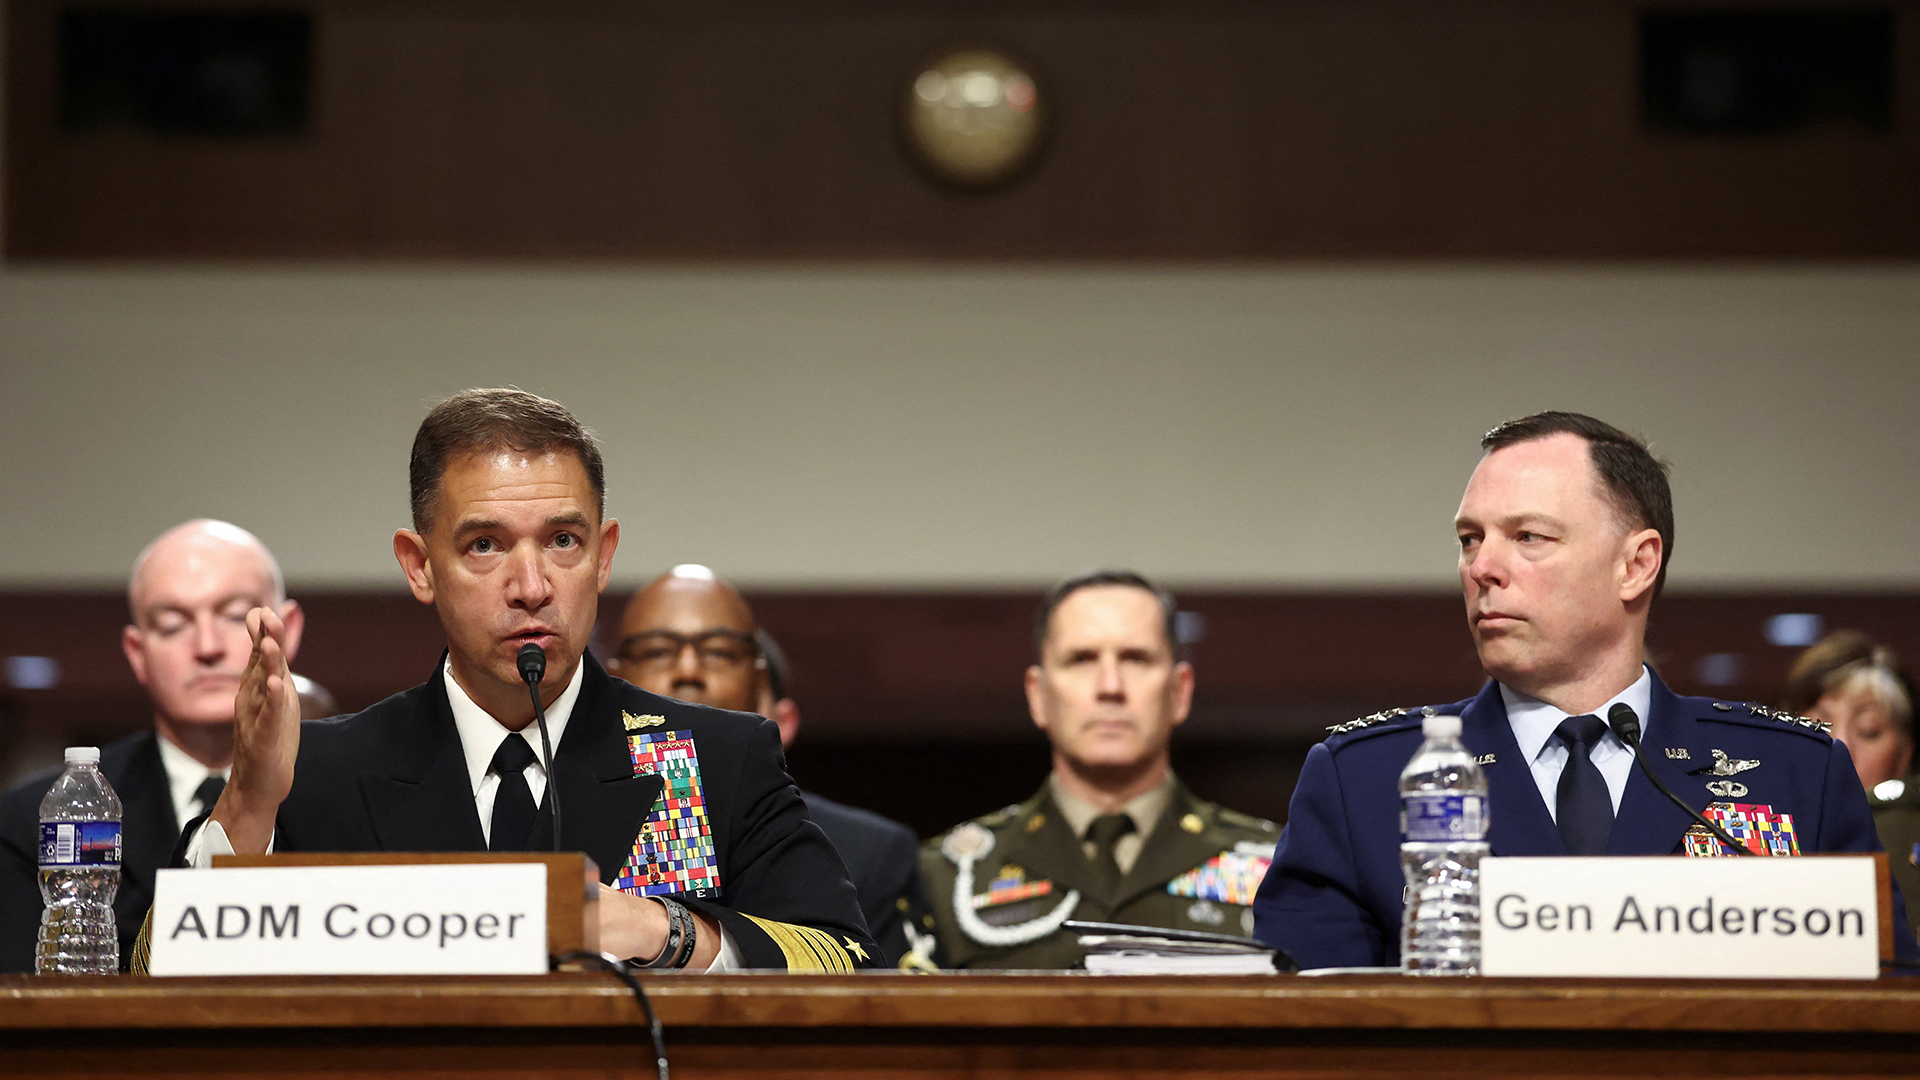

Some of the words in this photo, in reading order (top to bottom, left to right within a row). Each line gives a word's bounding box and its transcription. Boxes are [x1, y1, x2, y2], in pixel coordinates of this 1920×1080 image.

[695, 888, 707, 898] E
[1494, 893, 1593, 932] Gen
[1613, 895, 1865, 938] Anderson
[170, 904, 301, 939] ADM
[324, 903, 525, 948] Cooper
